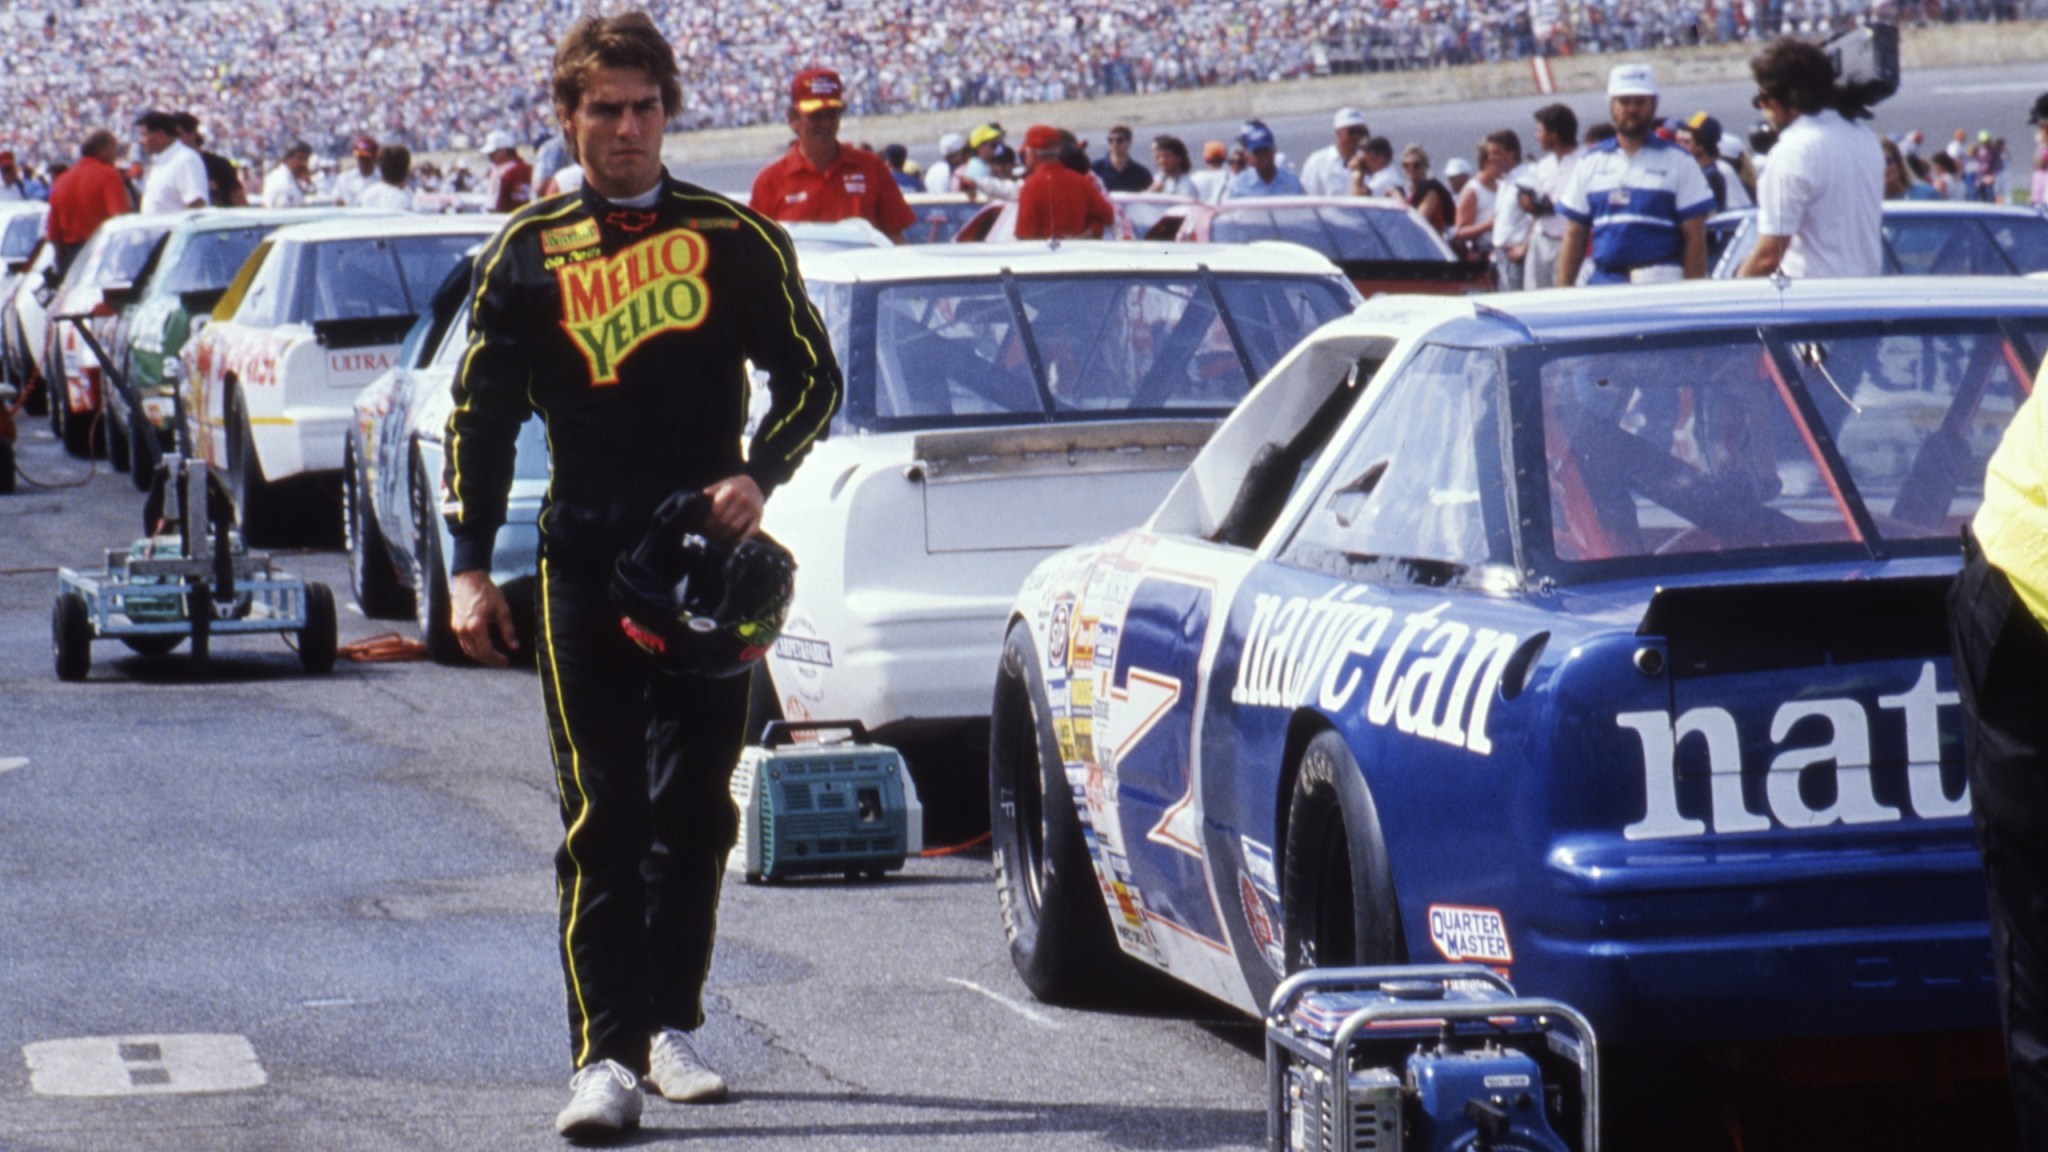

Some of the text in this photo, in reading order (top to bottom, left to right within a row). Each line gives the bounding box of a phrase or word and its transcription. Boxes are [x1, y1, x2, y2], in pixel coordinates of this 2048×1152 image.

[566, 234, 700, 323] MELLO
[576, 278, 702, 377] YELLO
[331, 353, 389, 372] ULTRA
[1231, 582, 1518, 756] native tan
[1431, 910, 1500, 941] QUARTER
[1446, 931, 1507, 957] MASTER
